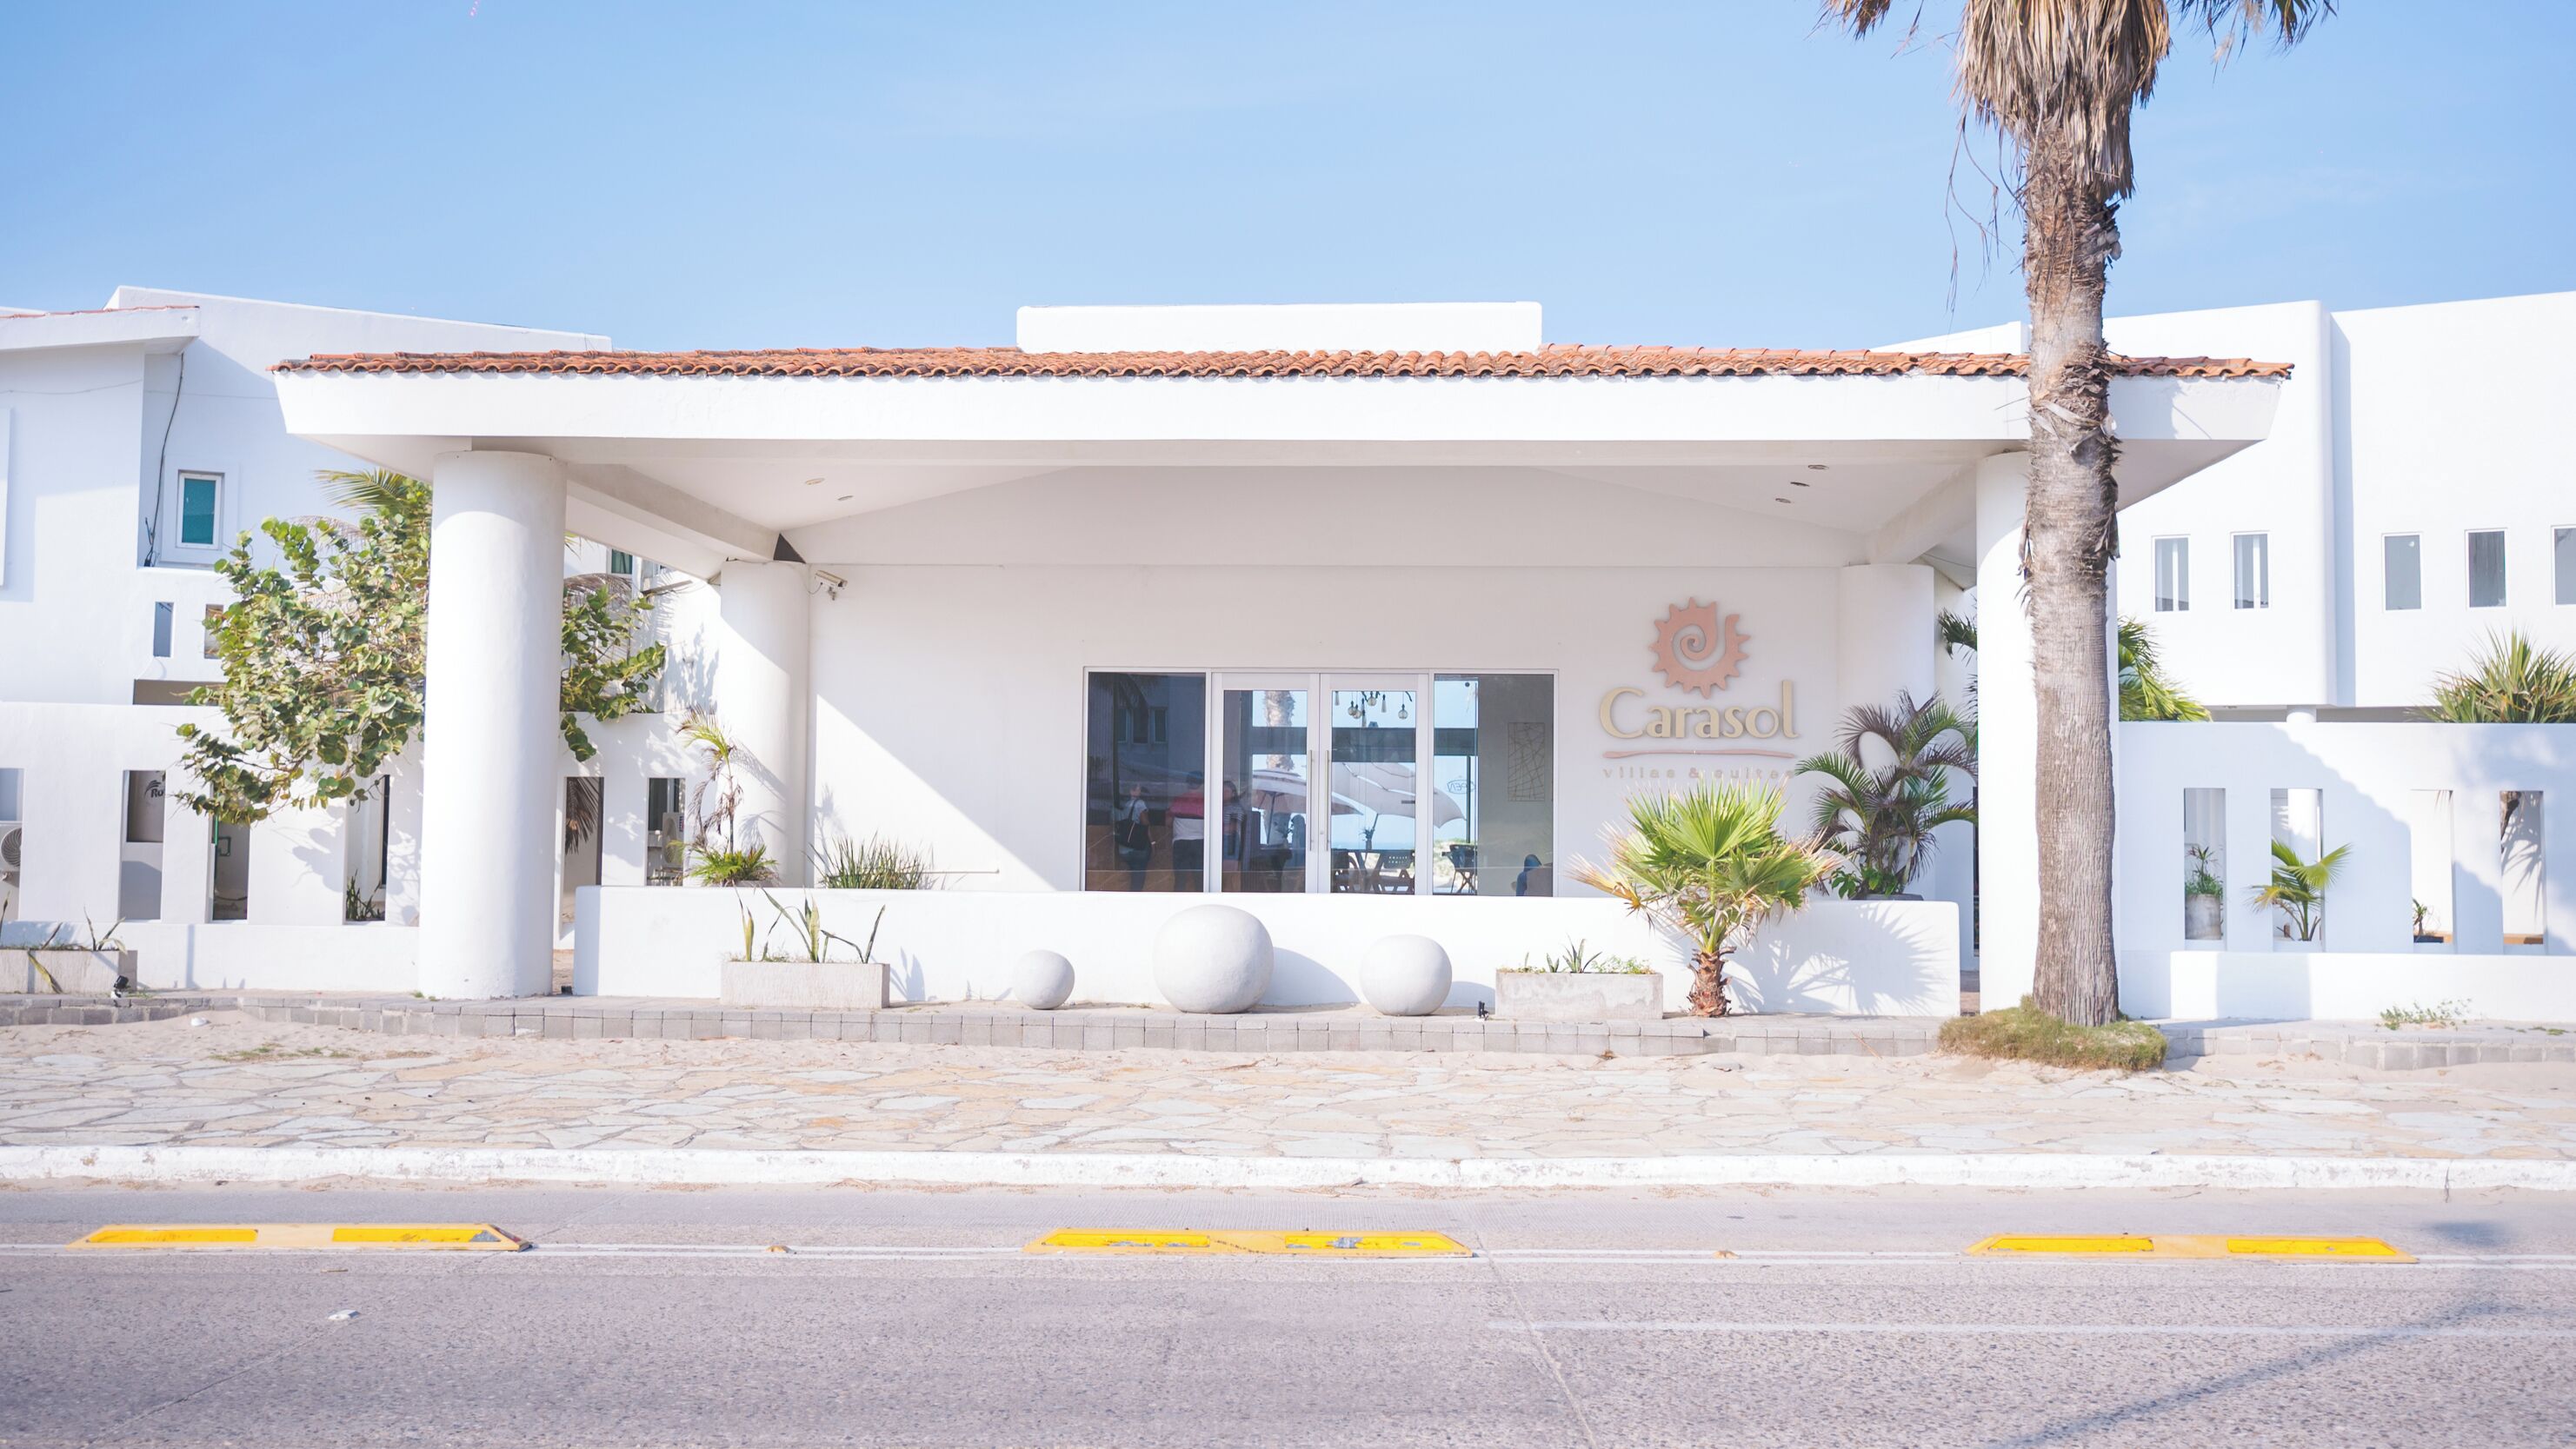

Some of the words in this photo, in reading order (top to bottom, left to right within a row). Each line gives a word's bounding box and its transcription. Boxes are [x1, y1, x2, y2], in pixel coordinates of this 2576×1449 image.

[1599, 680, 1800, 739] Carasol
[1602, 766, 1675, 779] villas
[1688, 767, 1701, 779] &
[1714, 766, 1794, 779] suites
